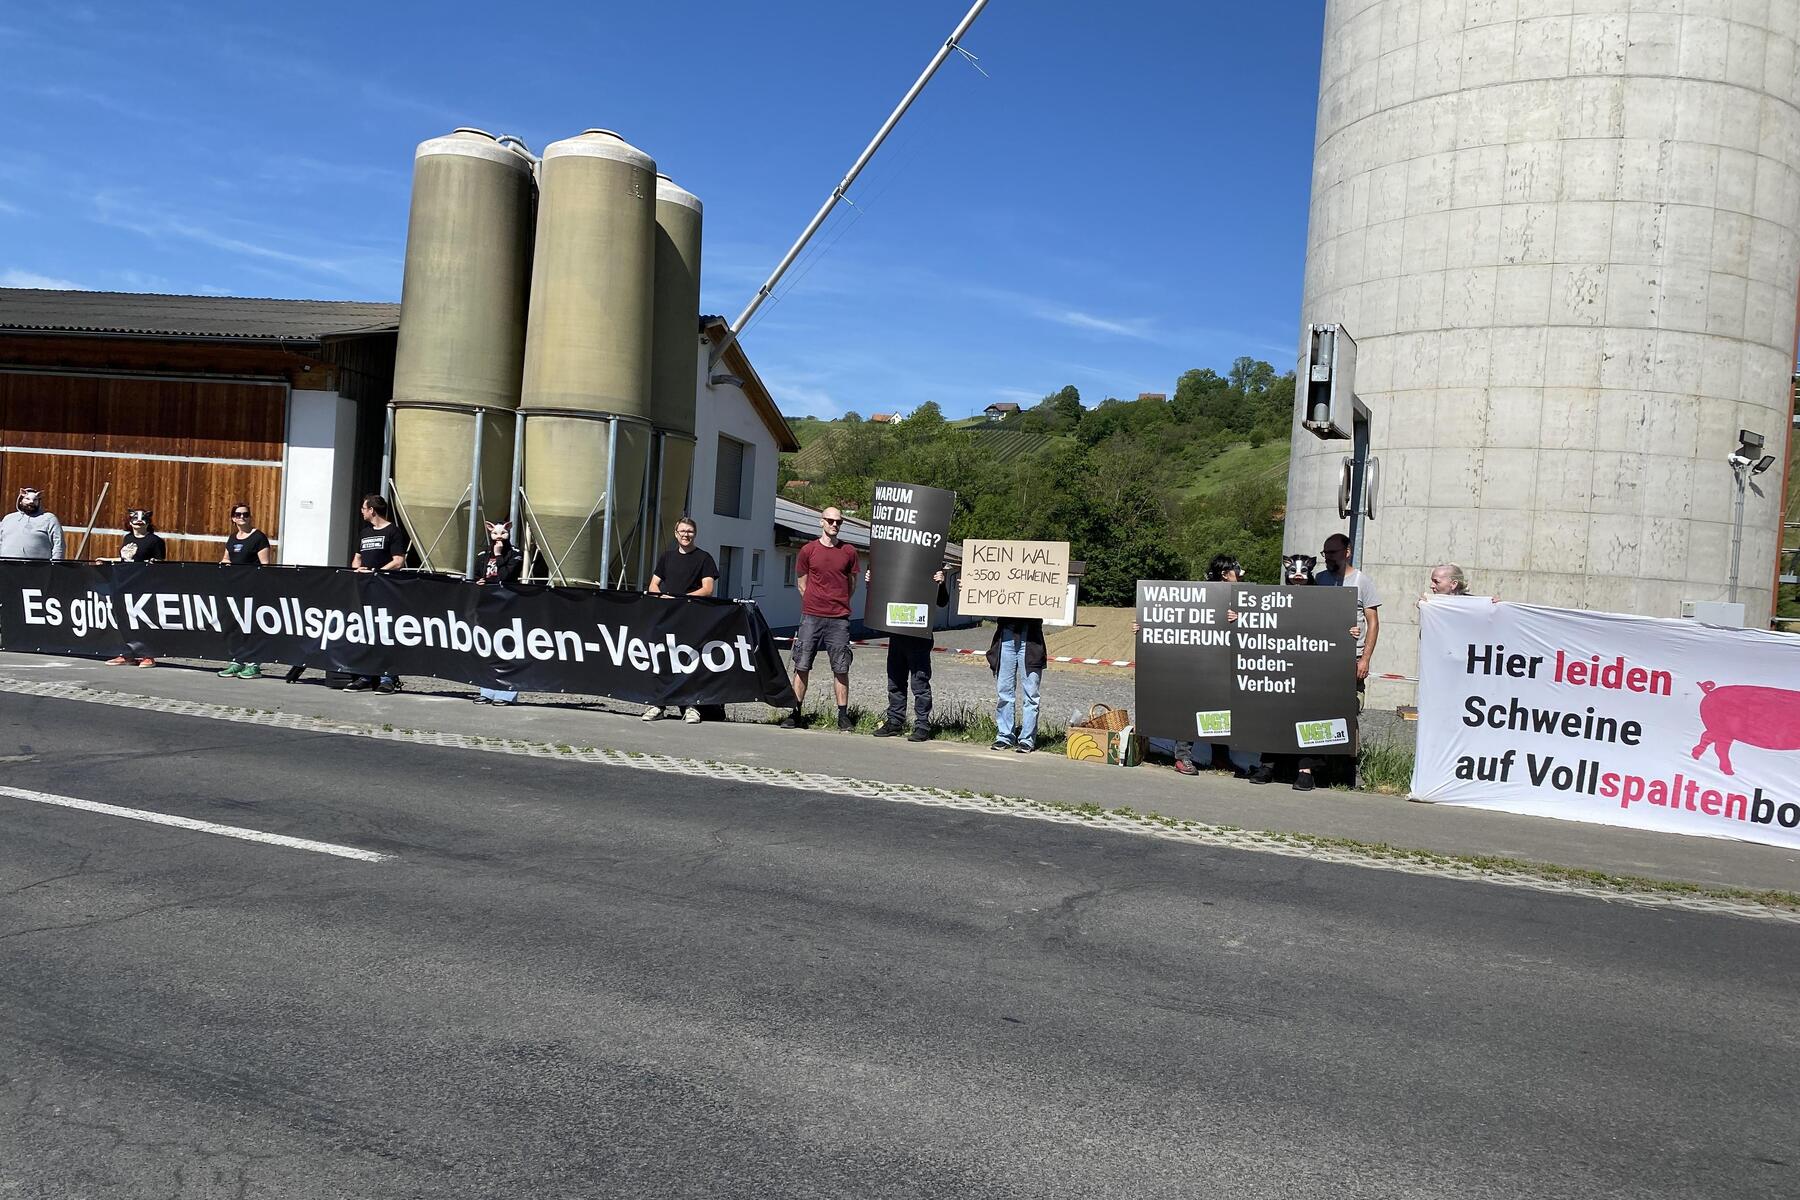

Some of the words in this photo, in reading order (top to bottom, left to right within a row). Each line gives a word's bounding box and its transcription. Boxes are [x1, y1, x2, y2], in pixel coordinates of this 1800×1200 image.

[875, 486, 914, 504] WARUM
[872, 503, 895, 521] LÜGT
[894, 507, 918, 525] DIE
[871, 524, 941, 548] REGIERUNG?
[972, 545, 1013, 564] KEIN
[1022, 547, 1060, 567] WAL.
[967, 569, 1001, 581] ~3500
[967, 589, 1025, 605] EMPÖRT
[1143, 586, 1207, 603] WARUM
[1237, 591, 1257, 608] Es
[1260, 591, 1294, 611] gibt
[1143, 603, 1186, 623] LÜGT
[1188, 608, 1216, 625] DIE
[1237, 612, 1278, 629] KEIN
[22, 588, 63, 626] Es
[70, 590, 119, 637] gibt
[124, 593, 223, 633] KEIN
[226, 596, 756, 675] Vollspaltenboden-Verbot
[1236, 633, 1337, 654] Vollspalten-
[1237, 654, 1294, 672] boden-
[1466, 643, 1543, 679] Hier
[1554, 650, 1672, 696] leiden
[1236, 674, 1296, 694] Verbot!
[1462, 696, 1642, 746] Schweine
[1455, 750, 1516, 782] auf
[1526, 753, 1800, 828] Vollspaltenbo
